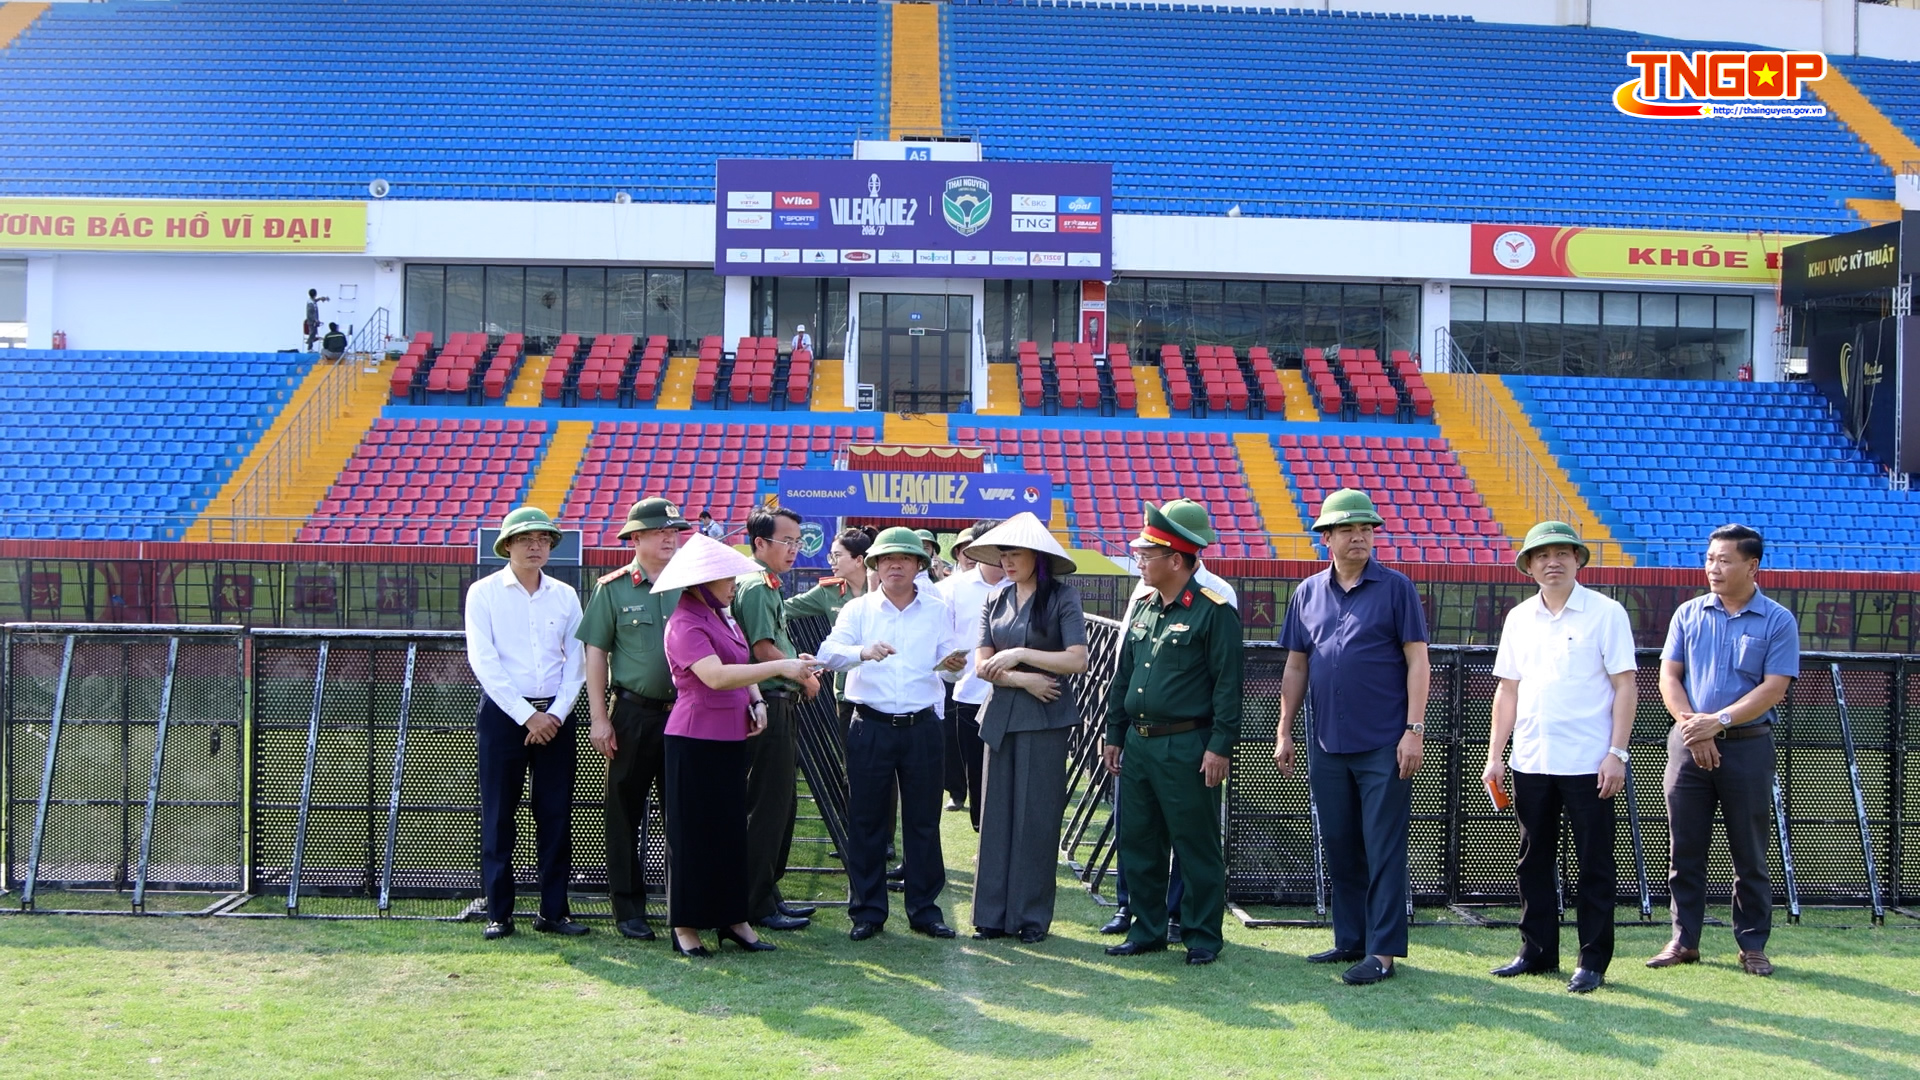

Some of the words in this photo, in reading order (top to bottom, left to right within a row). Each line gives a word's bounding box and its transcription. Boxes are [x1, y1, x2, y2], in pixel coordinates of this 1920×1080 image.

[909, 150, 927, 161] A5
[948, 179, 962, 190] THAI
[963, 178, 987, 190] NGUYEN
[781, 196, 813, 206] Wika
[1068, 201, 1092, 212] Opal
[87, 213, 153, 238] BÁC
[165, 211, 210, 239] HỒ
[222, 213, 255, 239] VĨ
[263, 217, 332, 243] ĐẠI!
[1014, 218, 1052, 229] TNG
[1628, 244, 1749, 268] KHỎE
[1808, 260, 1827, 278] KHU
[1828, 254, 1848, 277] VỰC
[1849, 249, 1863, 270] KỸ
[1864, 243, 1895, 269] THUẬT
[787, 488, 847, 499] SACOMBANK
[901, 503, 928, 515] 2026/27
